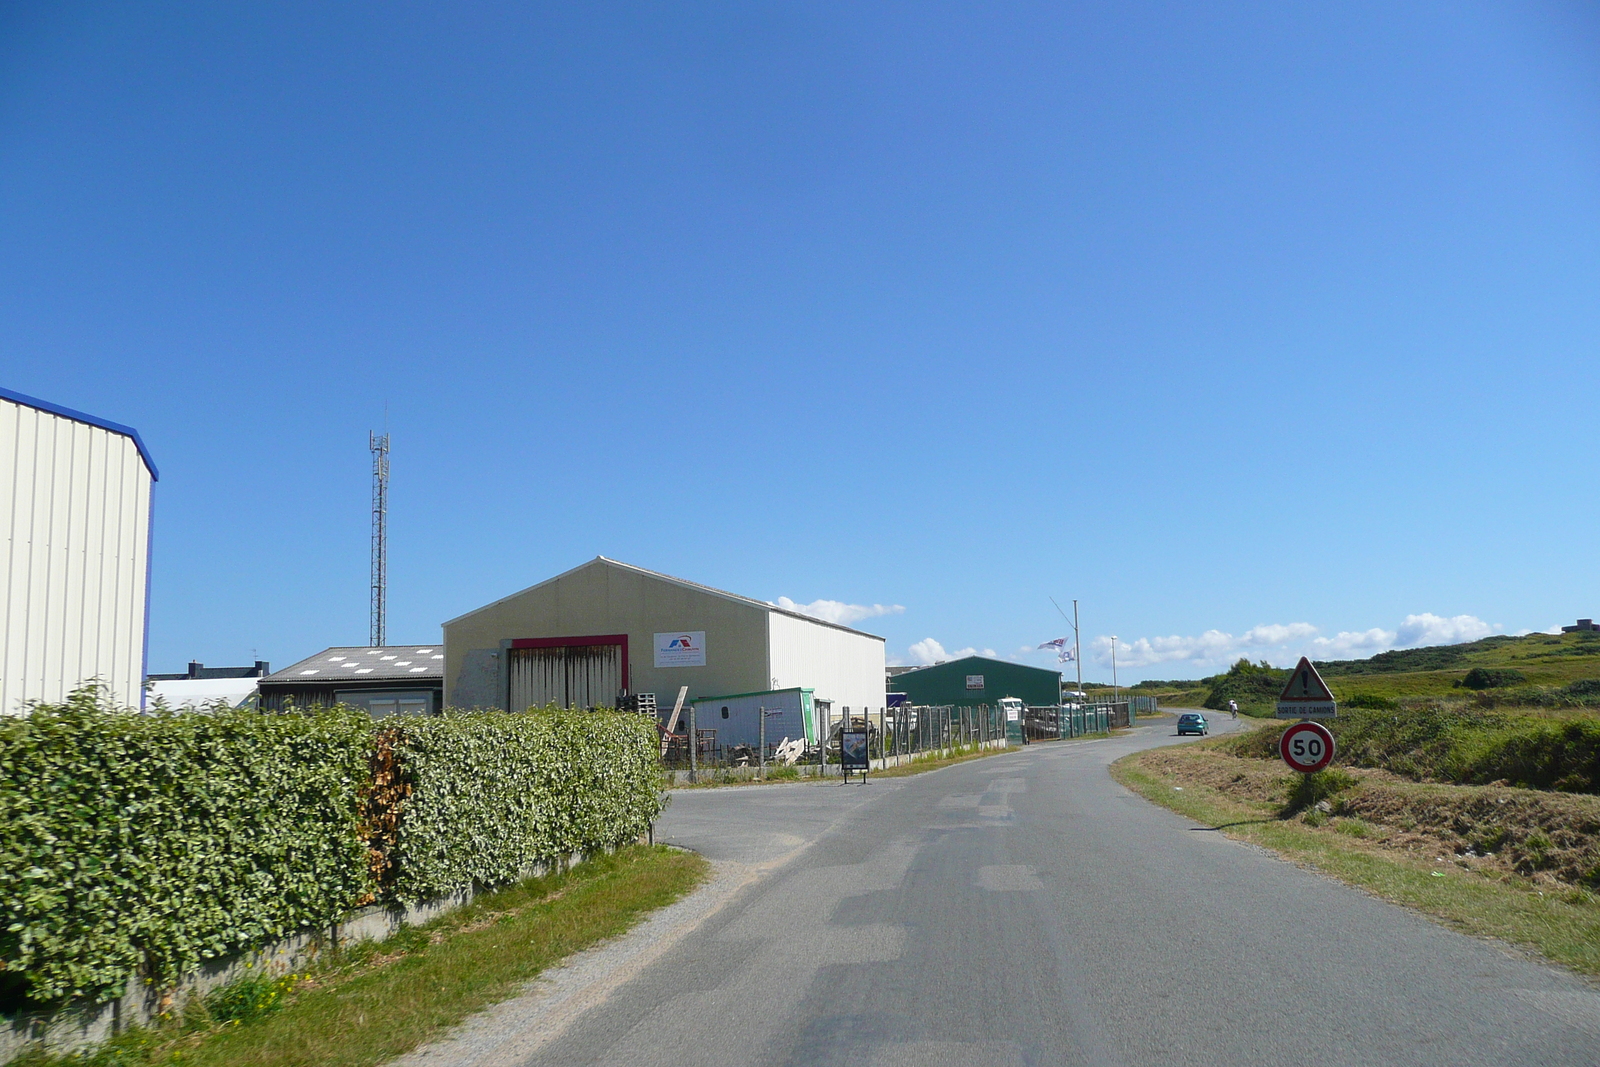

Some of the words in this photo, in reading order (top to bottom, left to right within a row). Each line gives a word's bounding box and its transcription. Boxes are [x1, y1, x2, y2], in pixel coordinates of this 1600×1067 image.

[1277, 706, 1297, 715] SORTIE
[1299, 706, 1307, 714] DE
[1308, 706, 1335, 714] CAMIONS
[1293, 739, 1321, 757] 50
